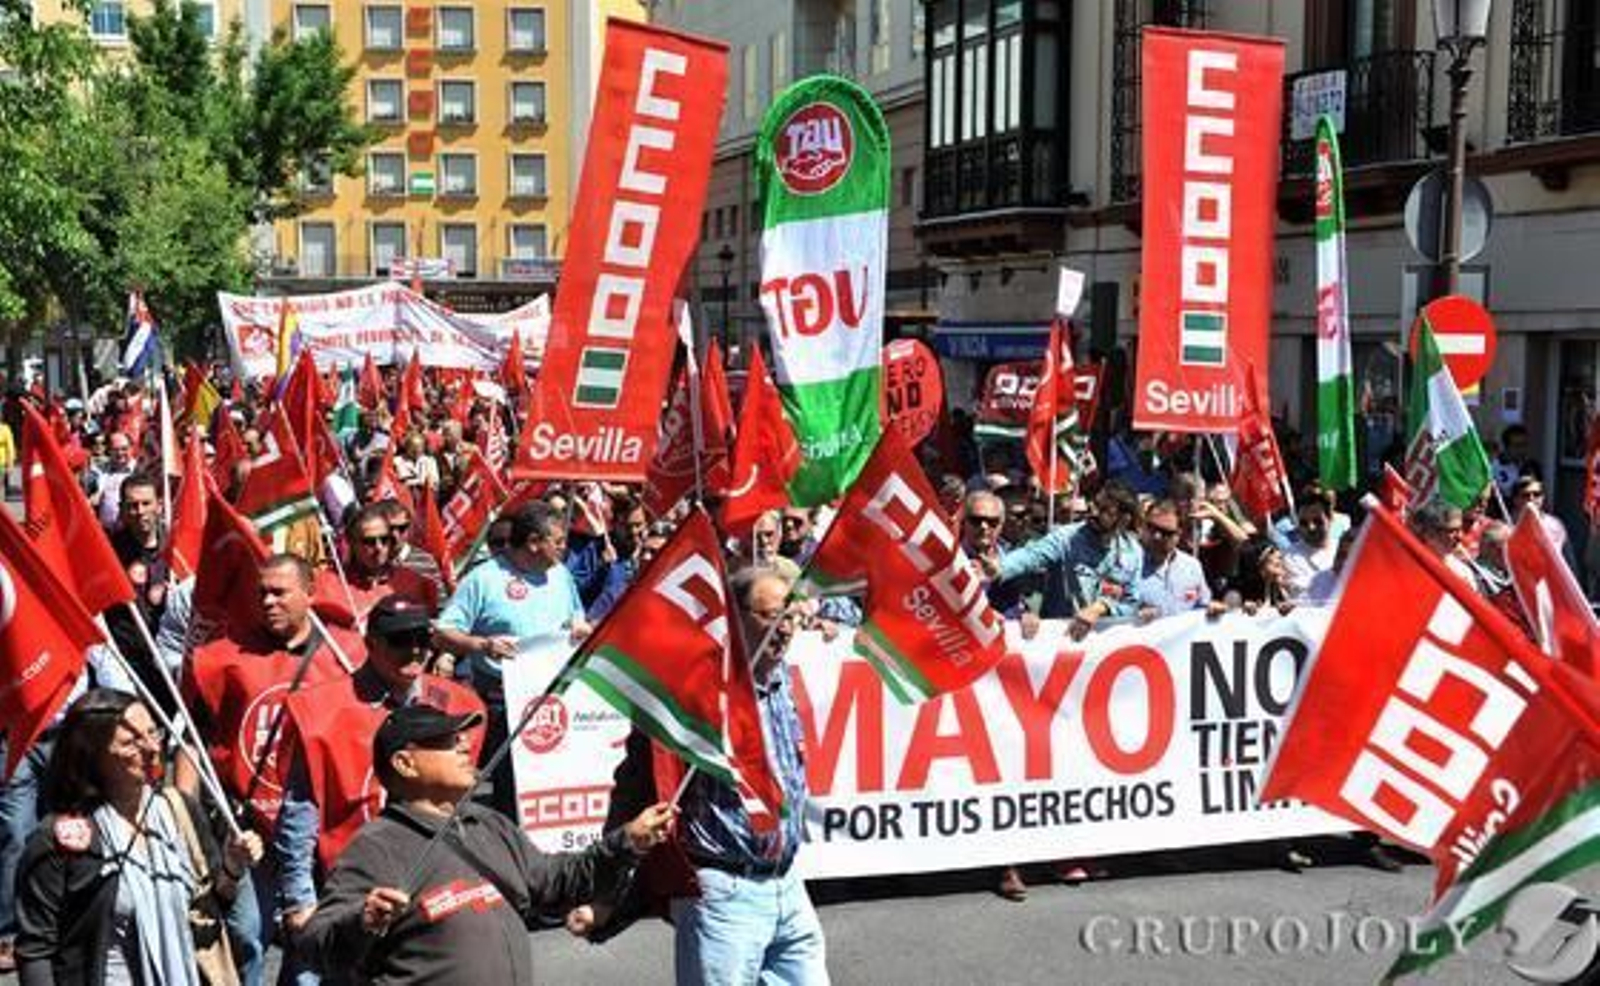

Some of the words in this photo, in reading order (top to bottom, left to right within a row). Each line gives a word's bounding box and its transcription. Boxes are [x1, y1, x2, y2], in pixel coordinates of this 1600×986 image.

[587, 47, 688, 340] CCOO
[1180, 49, 1237, 304] CCOO
[887, 356, 927, 388] ERO
[529, 422, 643, 464] Sevilla
[862, 472, 1005, 648] CCOO
[903, 585, 972, 667] Sevilla
[1190, 637, 1308, 720] NO
[790, 643, 1177, 797] MAYO
[1191, 720, 1278, 768] TIEN
[824, 803, 903, 843] POR
[911, 796, 981, 838] TUS
[992, 782, 1176, 830] DERECHOS
